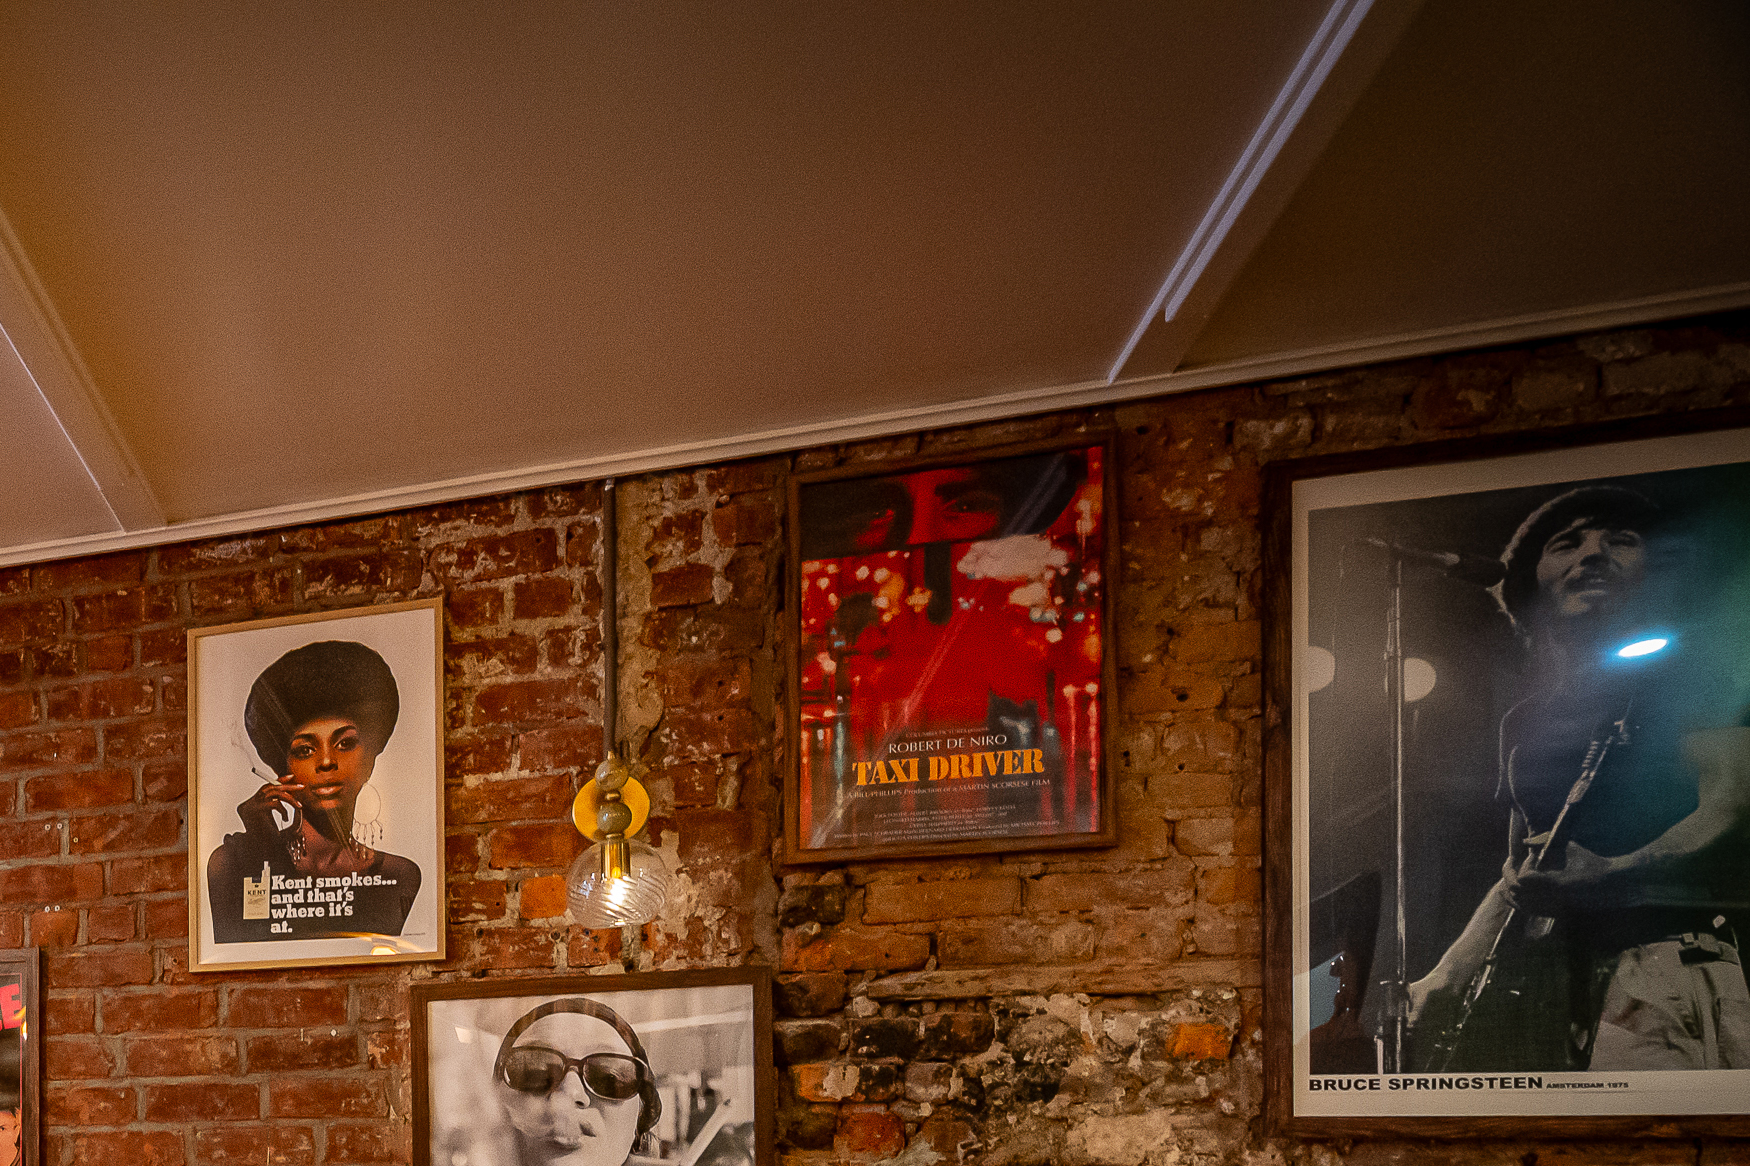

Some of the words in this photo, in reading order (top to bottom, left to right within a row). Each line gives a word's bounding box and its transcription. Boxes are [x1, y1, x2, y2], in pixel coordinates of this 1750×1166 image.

[889, 740, 943, 754] ROBERT
[947, 738, 965, 749] DE
[970, 734, 1008, 748] NIRO
[852, 758, 920, 786] TAXI
[928, 748, 1045, 781] DRIVER
[271, 875, 313, 890] Kent
[315, 872, 398, 888] smokes...
[270, 888, 305, 904] and
[307, 886, 355, 903] that's
[270, 903, 326, 919] where
[328, 901, 354, 917] it's
[270, 920, 294, 933] at.
[1308, 1077, 1382, 1091] BRUCE
[1387, 1076, 1544, 1091] SPRINGSTEEN
